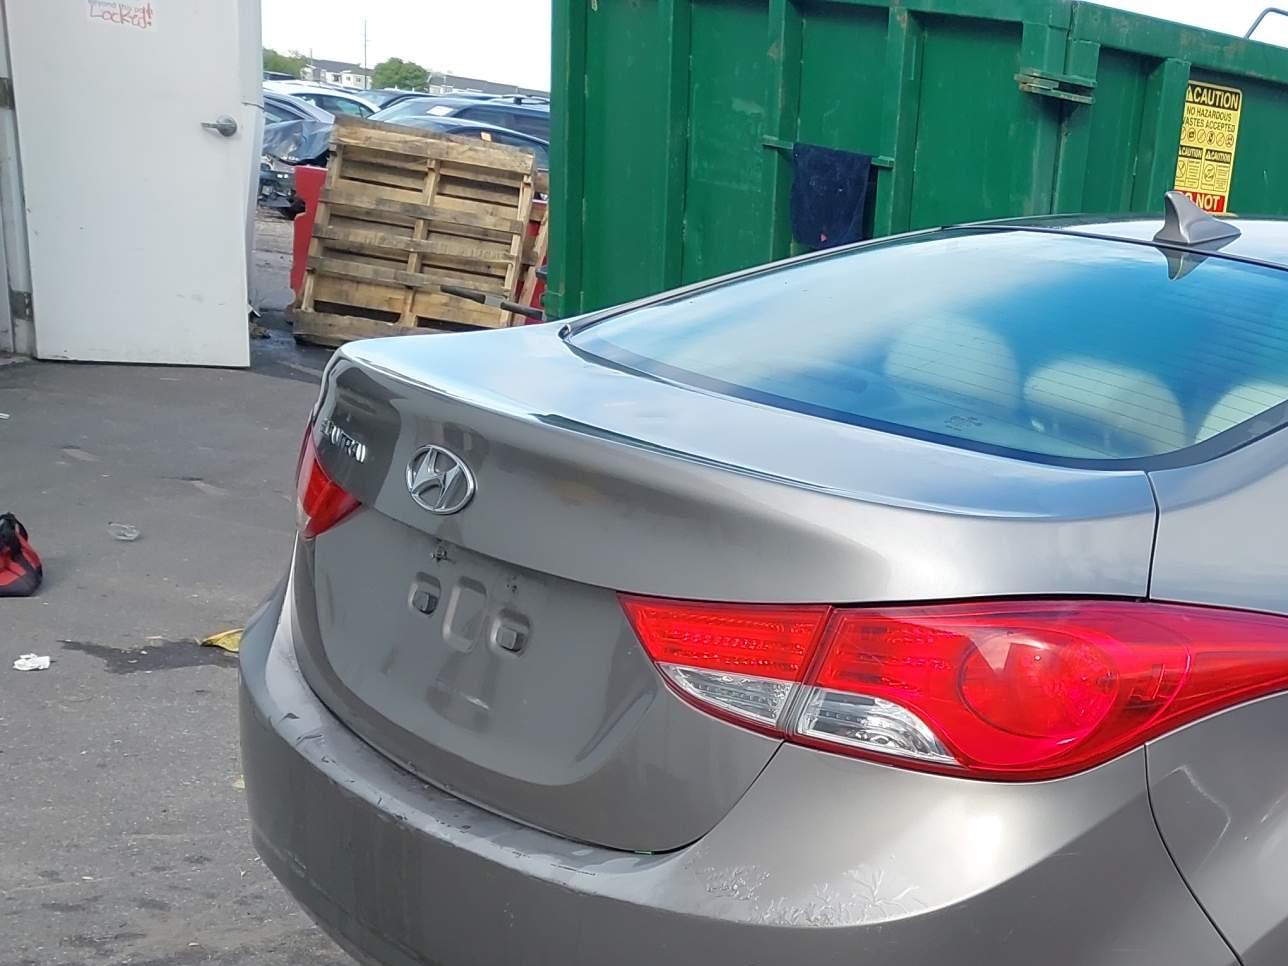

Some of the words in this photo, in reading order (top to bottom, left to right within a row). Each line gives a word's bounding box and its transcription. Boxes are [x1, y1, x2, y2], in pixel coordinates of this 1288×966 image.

[1193, 87, 1239, 110] CAUTION
[1187, 105, 1196, 116] NO
[1197, 107, 1232, 122] HAZARDOUS
[1205, 120, 1236, 133] ACCEPTED
[1181, 147, 1202, 159] CAUTION
[1195, 193, 1221, 211] NOT
